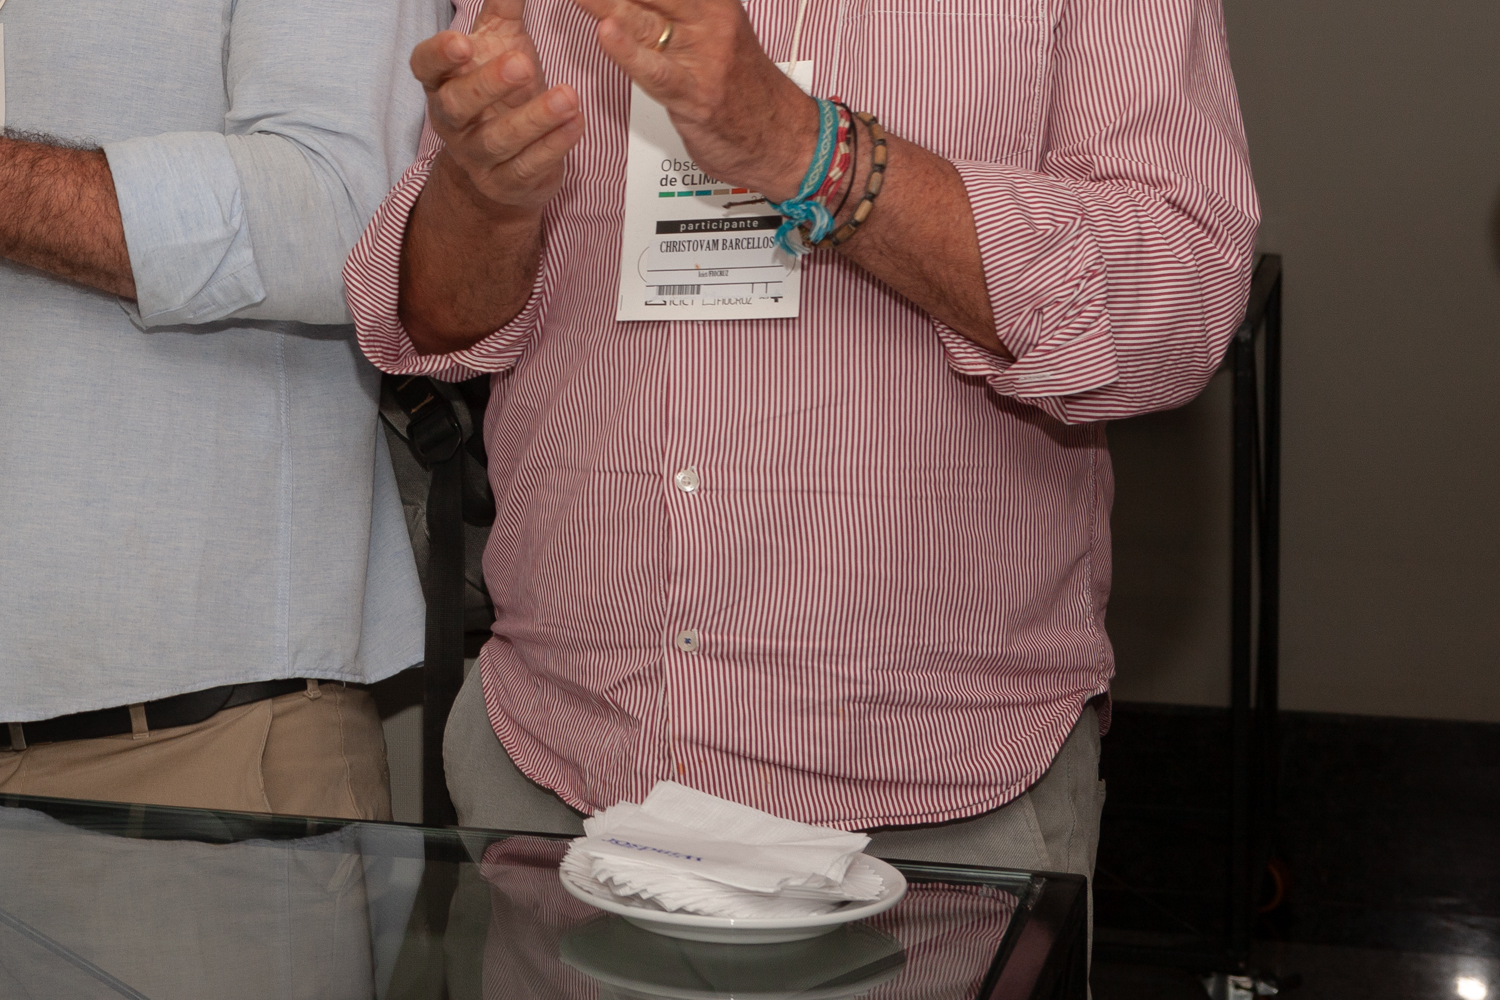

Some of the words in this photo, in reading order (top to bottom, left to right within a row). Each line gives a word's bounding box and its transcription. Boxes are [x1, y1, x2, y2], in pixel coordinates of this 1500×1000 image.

[659, 174, 678, 187] de
[680, 219, 759, 232] participante
[660, 238, 719, 253] CHRISTOVAM
[721, 236, 775, 251] BARCELLOS
